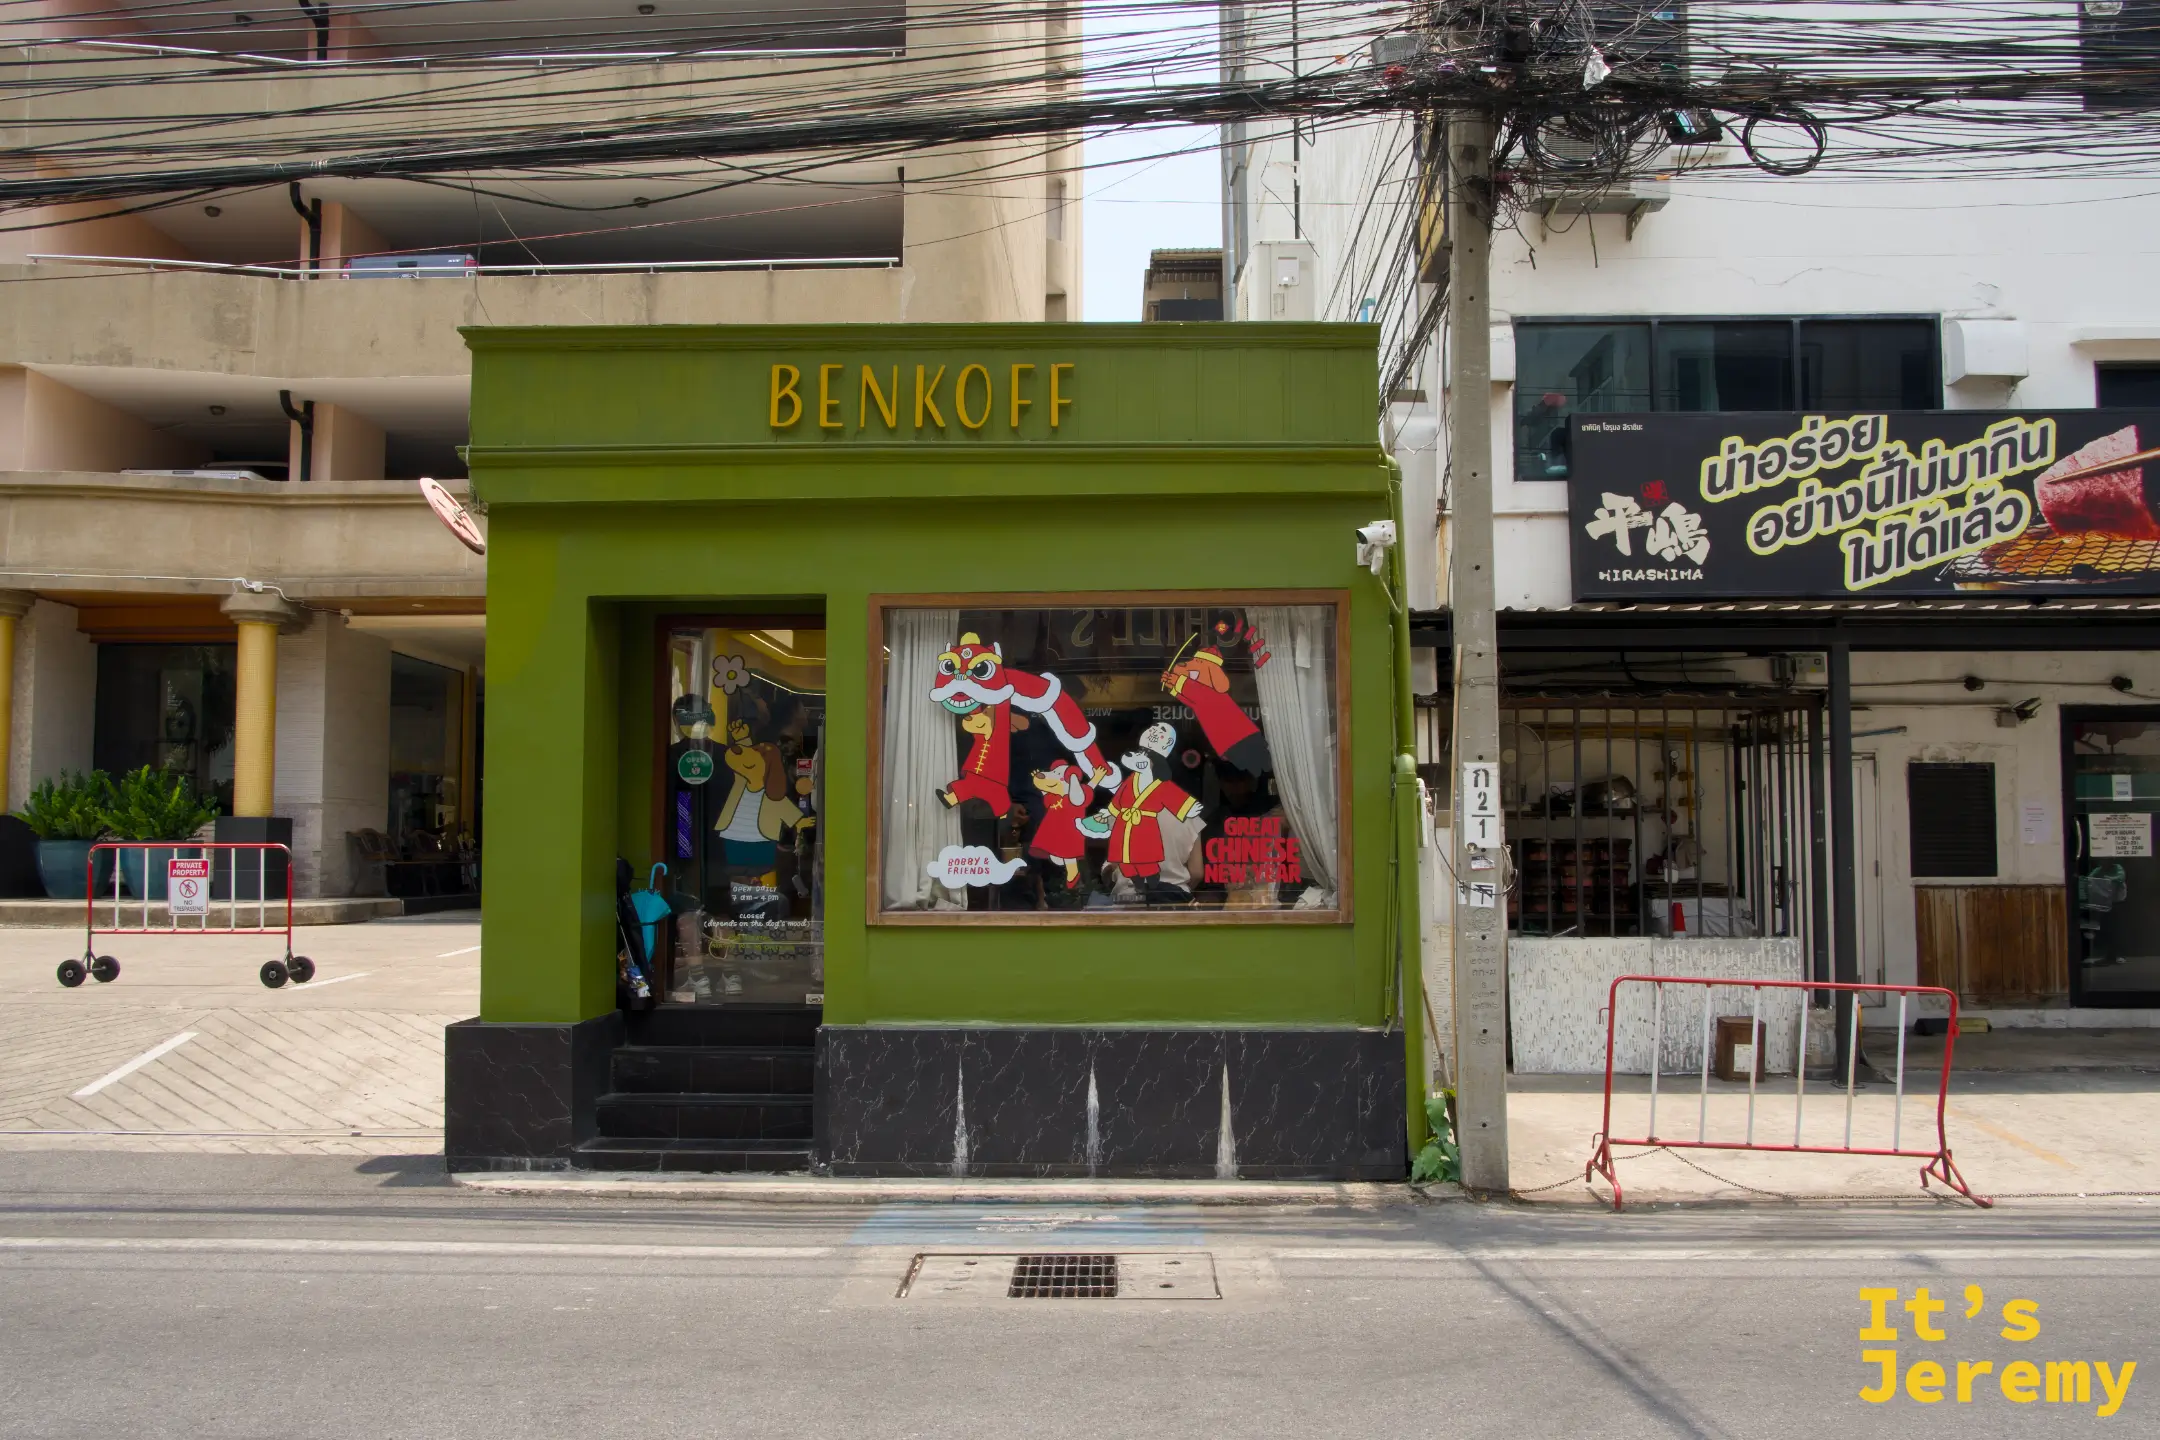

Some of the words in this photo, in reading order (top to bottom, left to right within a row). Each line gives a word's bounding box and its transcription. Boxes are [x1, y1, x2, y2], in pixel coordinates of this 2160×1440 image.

[769, 363, 1075, 429] BENKOFF
[1703, 413, 1885, 499] น่าอร่อย
[1750, 419, 2053, 552] อย่างนี้ไม่มากิน
[1844, 484, 2027, 587] ไม่ได้แล้ว
[1598, 568, 1704, 581] HIRASHIMA
[1477, 791, 1488, 810] 2
[1224, 816, 1281, 837] GREAT
[1479, 819, 1486, 839] 1
[1205, 837, 1300, 863] CHINESE
[947, 866, 990, 875] FRIENDS
[948, 857, 980, 867] BOBBY
[984, 857, 990, 865] &
[1204, 863, 1247, 883] NEW
[1252, 863, 1302, 883] YEAR
